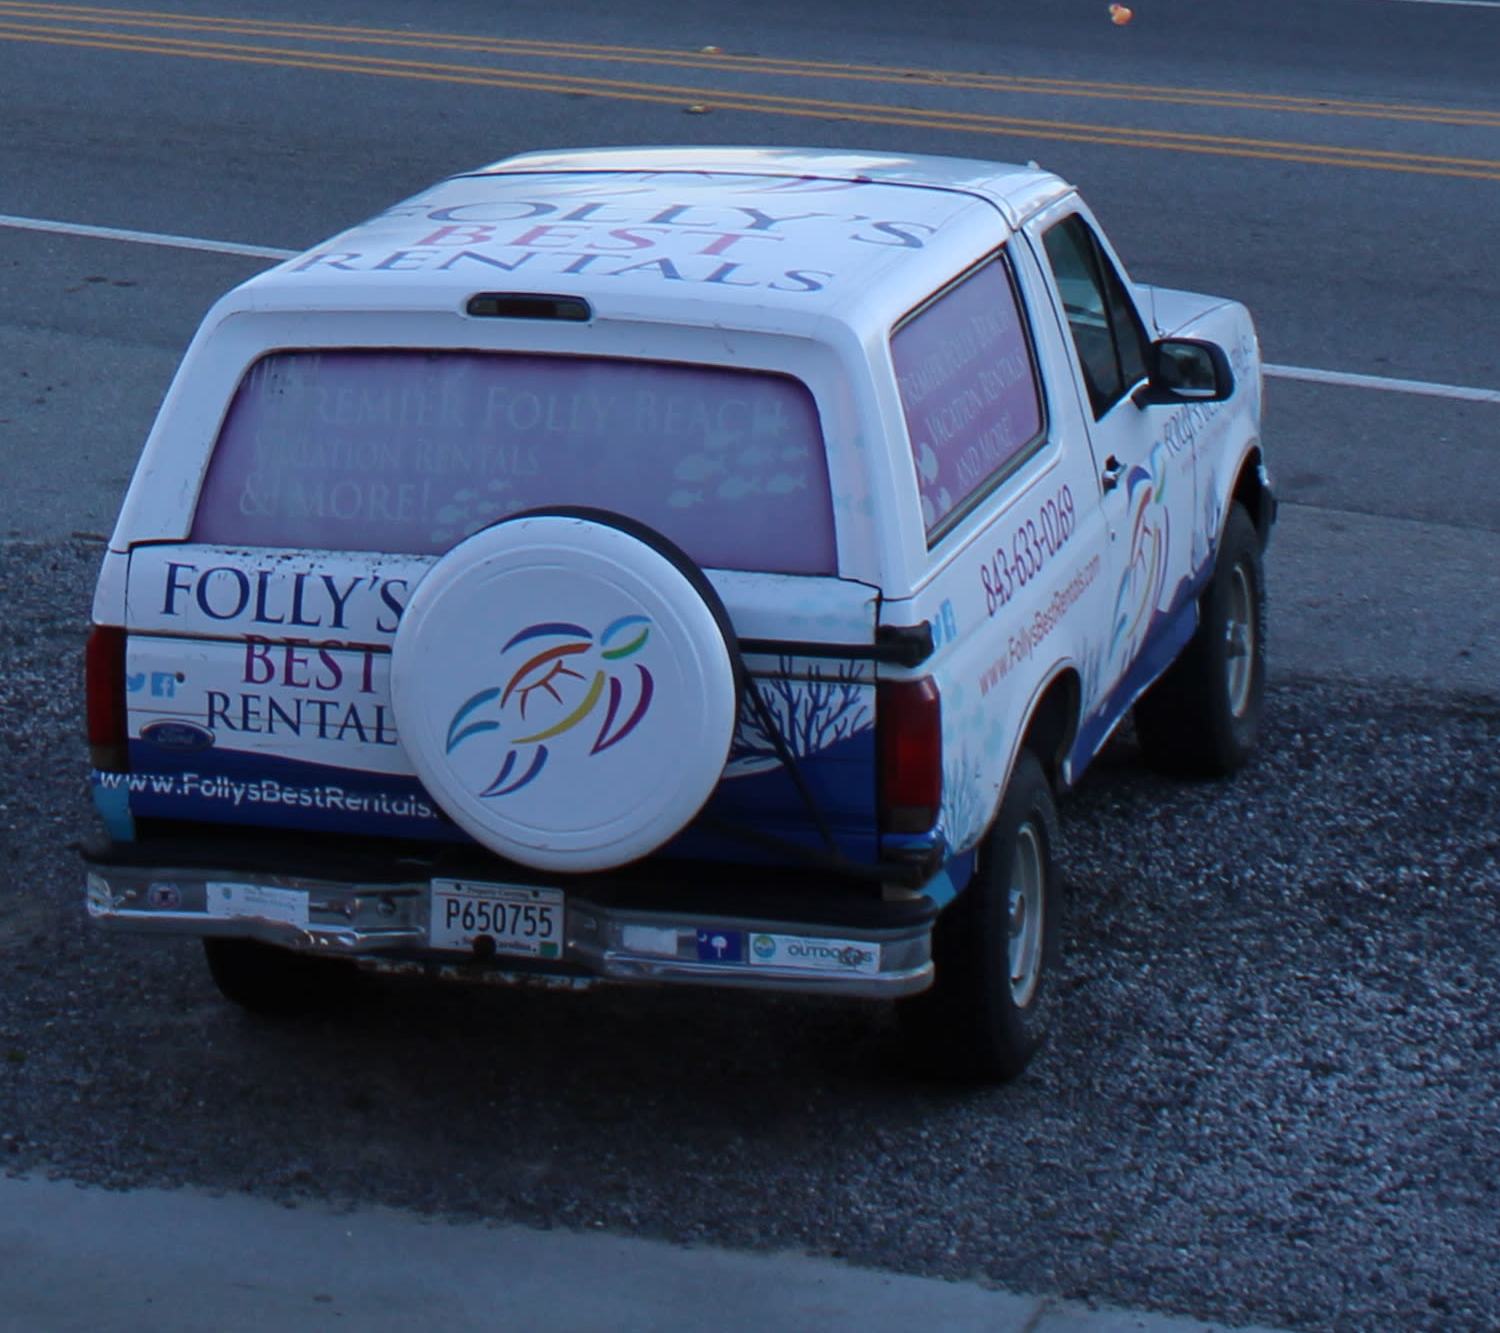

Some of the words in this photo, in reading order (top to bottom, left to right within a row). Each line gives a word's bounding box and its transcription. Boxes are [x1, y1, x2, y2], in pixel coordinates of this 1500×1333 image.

[390, 200, 937, 249] FOLLY'S
[412, 224, 785, 256] BEST
[290, 248, 836, 292] RENTALS
[282, 384, 466, 428] REMIER
[483, 386, 616, 432] FOLLY
[415, 437, 541, 477] RENTALS
[238, 471, 272, 516] &
[284, 479, 431, 523] MORE!
[980, 484, 1076, 617] 843-633-0269
[160, 561, 409, 634] FOLLY'S
[241, 633, 384, 693] BEST
[446, 898, 552, 937] P650755
